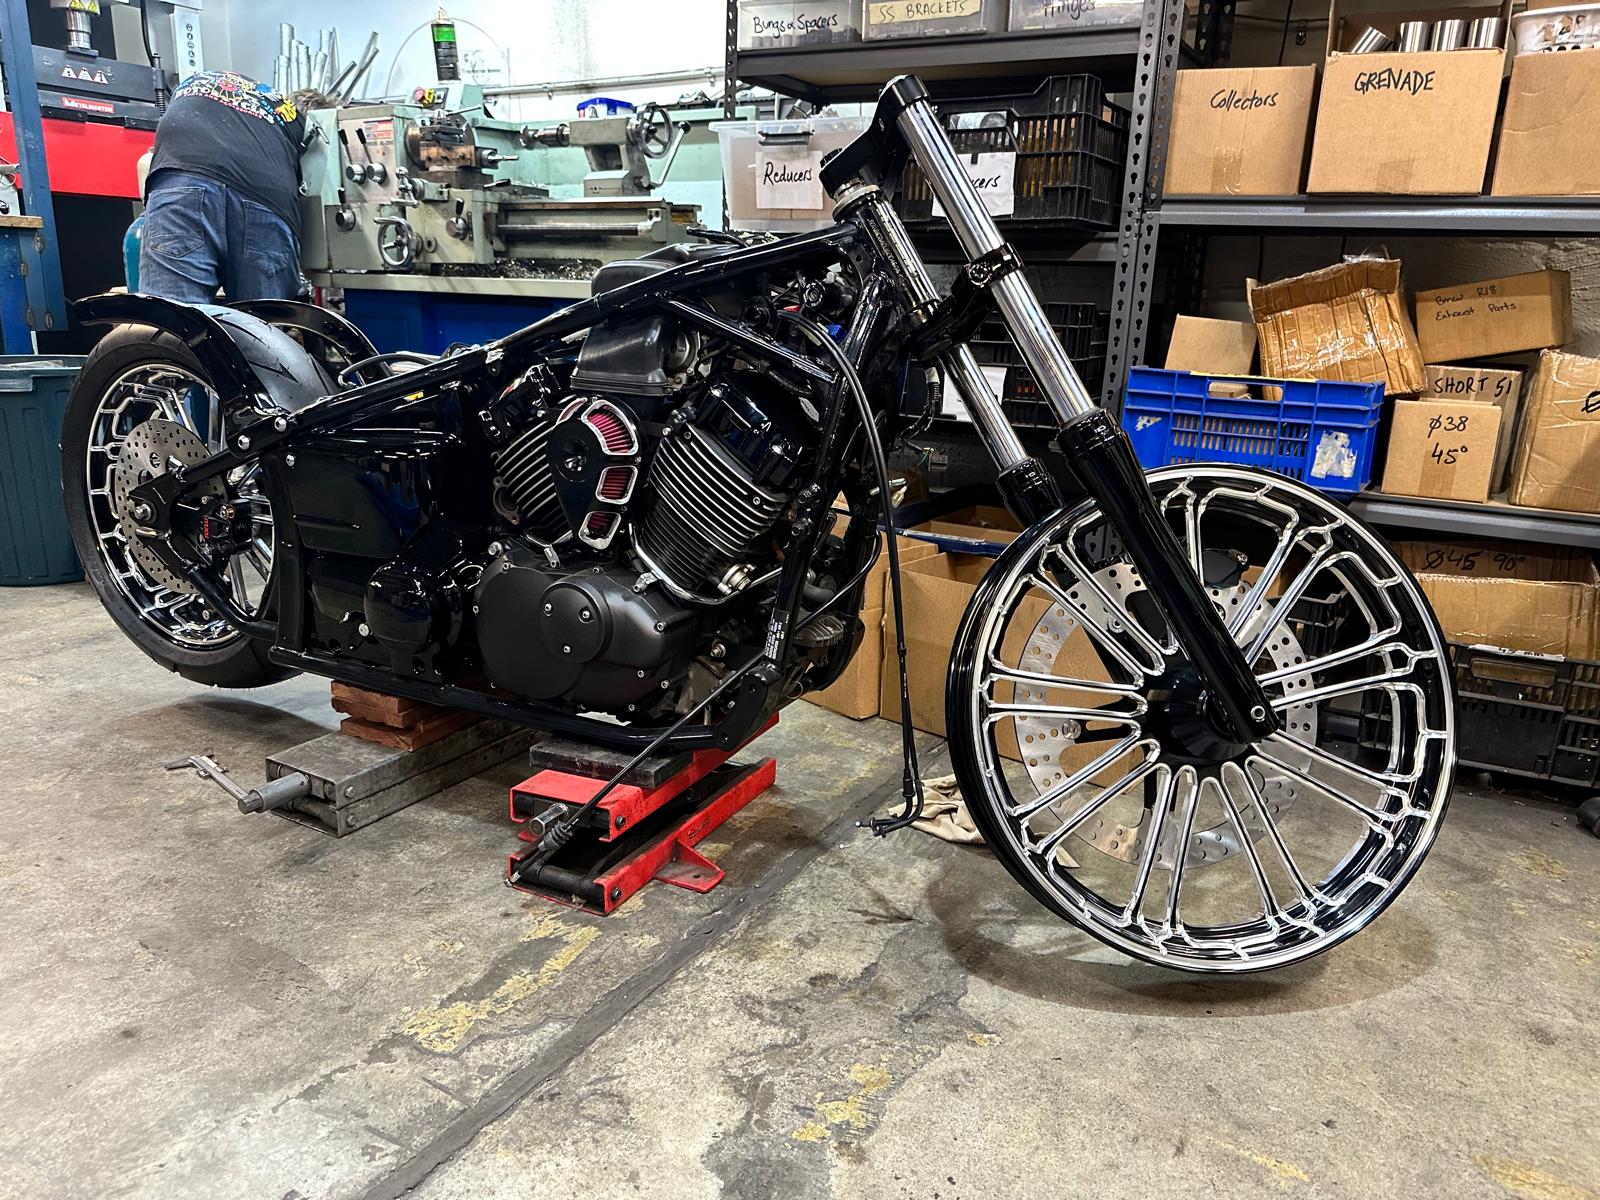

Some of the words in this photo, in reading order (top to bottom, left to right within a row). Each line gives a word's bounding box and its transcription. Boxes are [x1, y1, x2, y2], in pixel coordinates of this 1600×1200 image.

[880, 5, 895, 22] SS
[906, 0, 967, 19] BRACKETS
[753, 16, 785, 38] Bungs
[798, 14, 837, 33] Spacers
[1354, 67, 1436, 96] GRENADE
[1210, 89, 1279, 112] Collectors
[763, 161, 812, 186] Reducers
[971, 175, 1001, 189] cers
[1476, 285, 1497, 298] R18
[1435, 306, 1475, 321] Exhaust
[1488, 302, 1517, 312] Parts
[1434, 377, 1489, 394] SHORT
